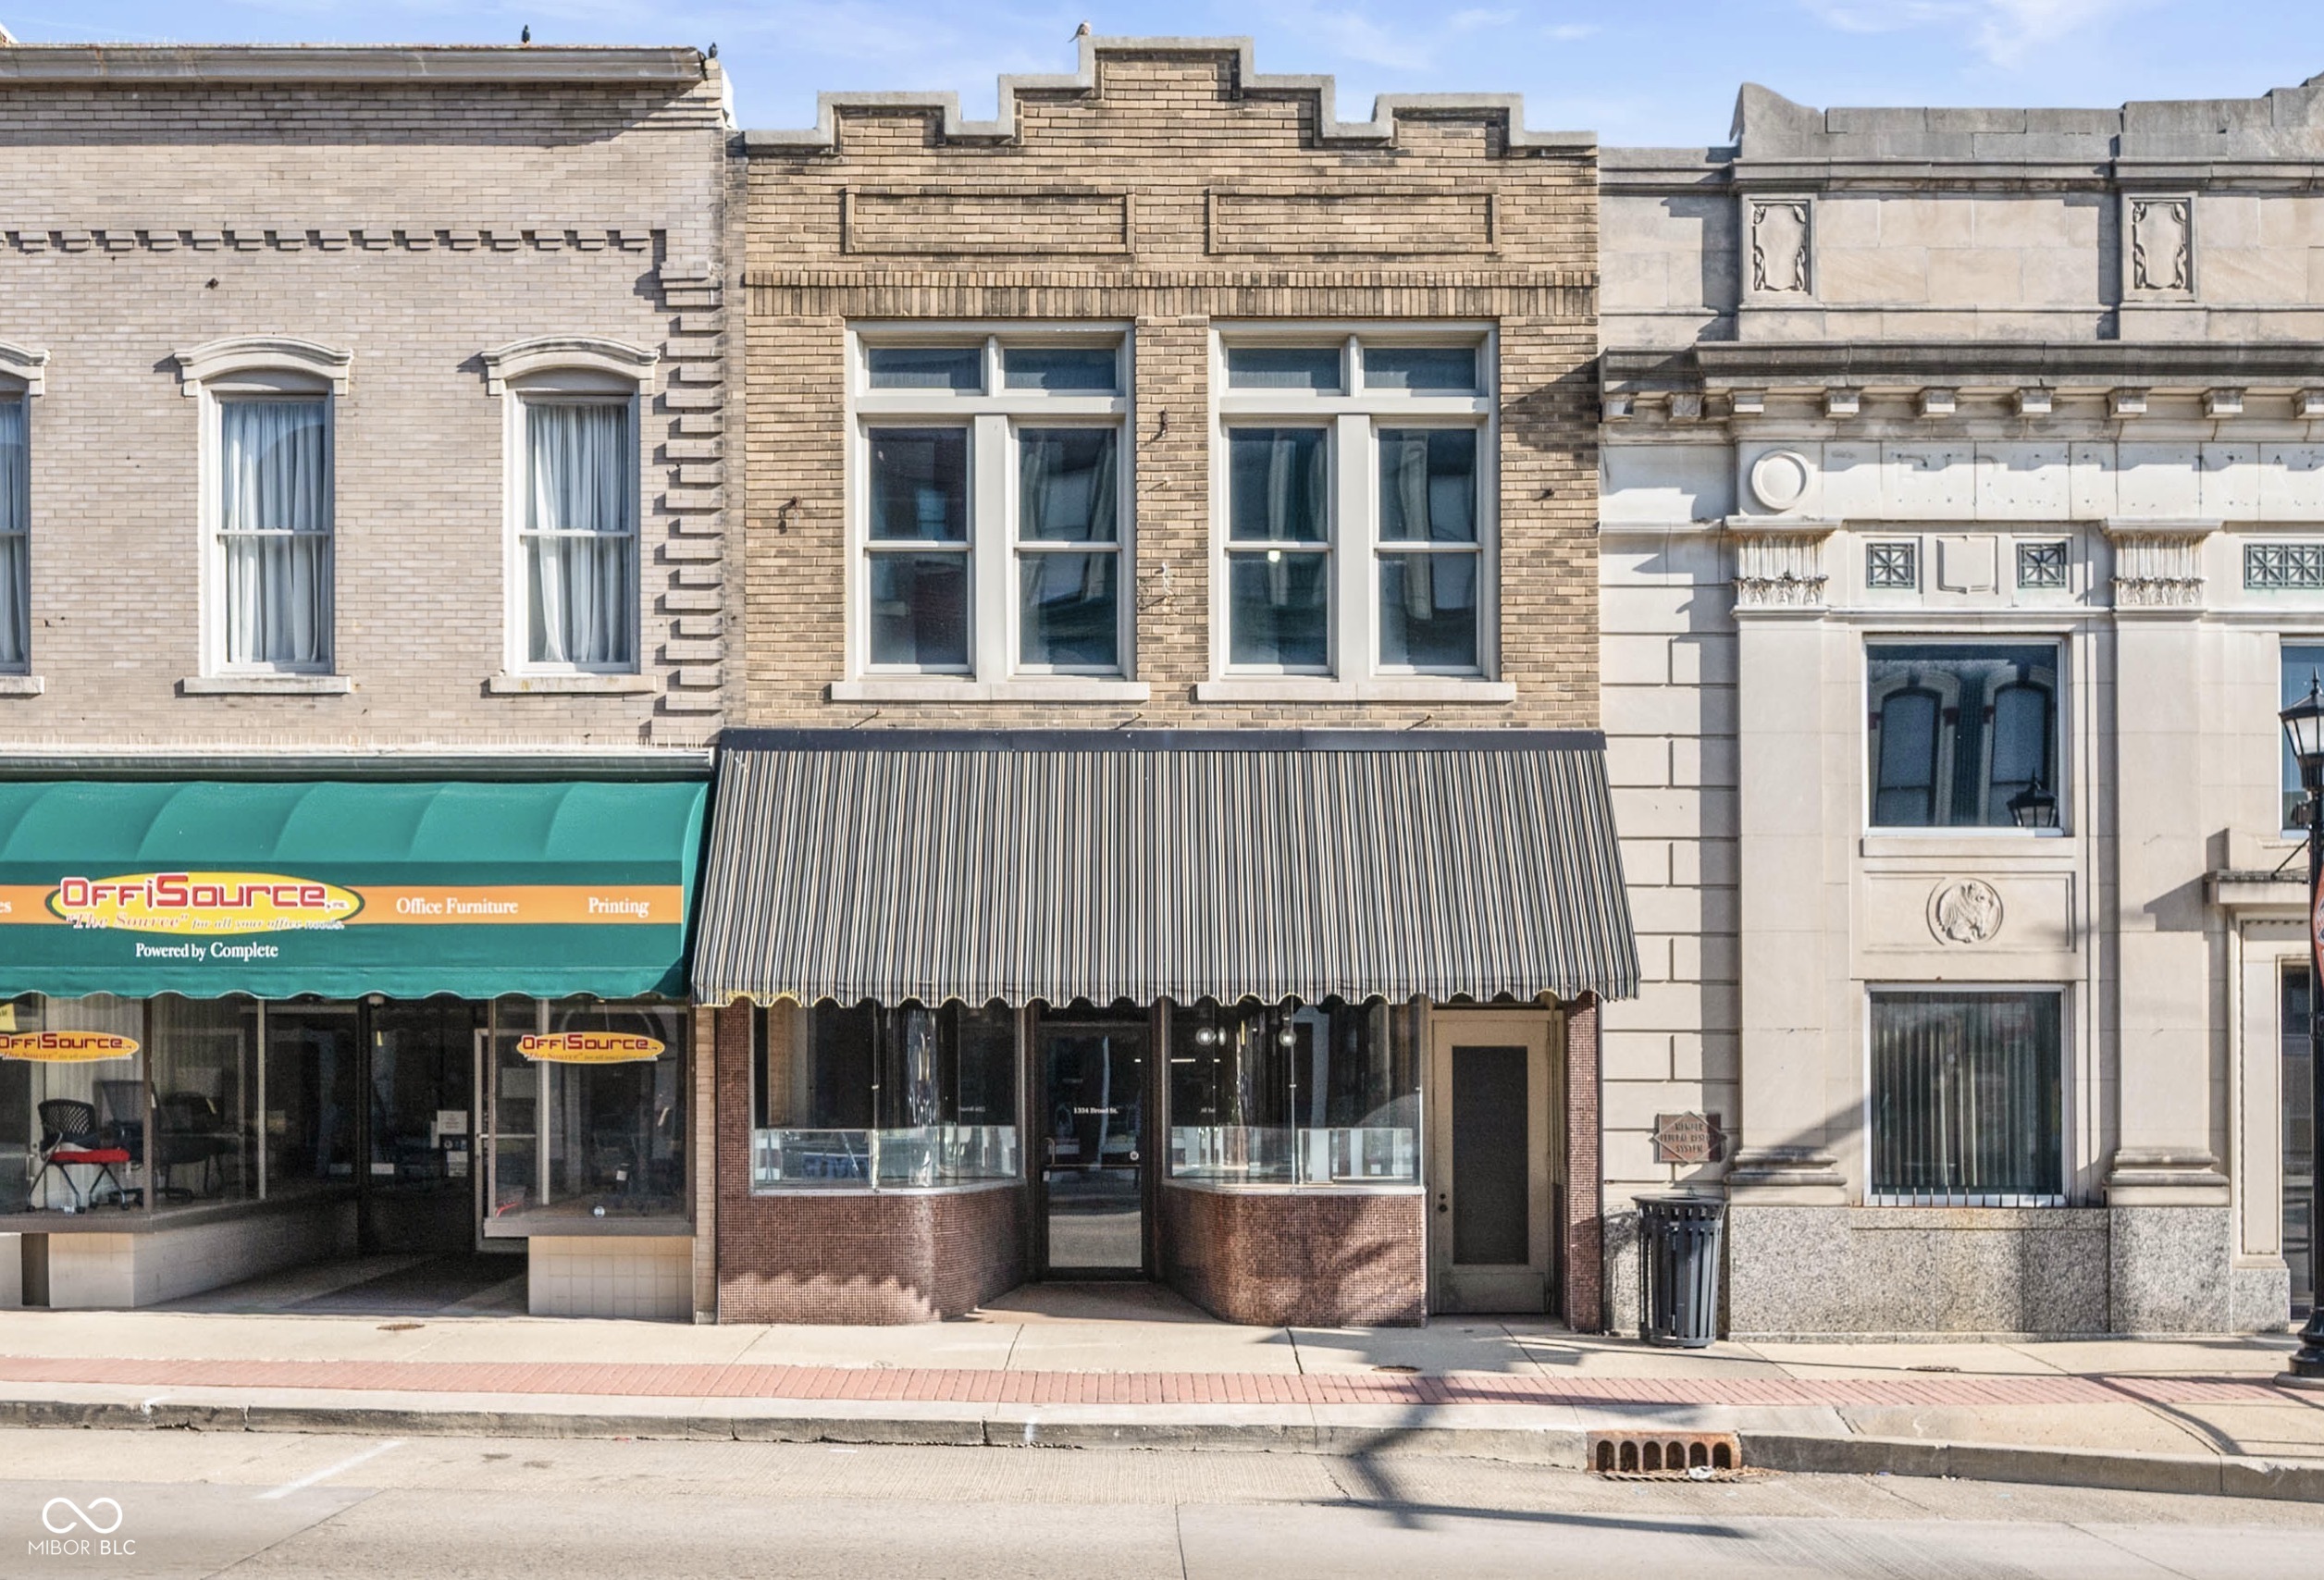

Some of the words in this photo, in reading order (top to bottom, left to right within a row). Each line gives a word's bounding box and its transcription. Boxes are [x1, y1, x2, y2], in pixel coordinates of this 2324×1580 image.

[396, 897, 443, 915] Office
[446, 897, 519, 915] Furniture
[587, 896, 650, 919] Printing
[135, 942, 190, 958] Powered
[191, 943, 206, 962] by
[210, 941, 279, 962] Complete
